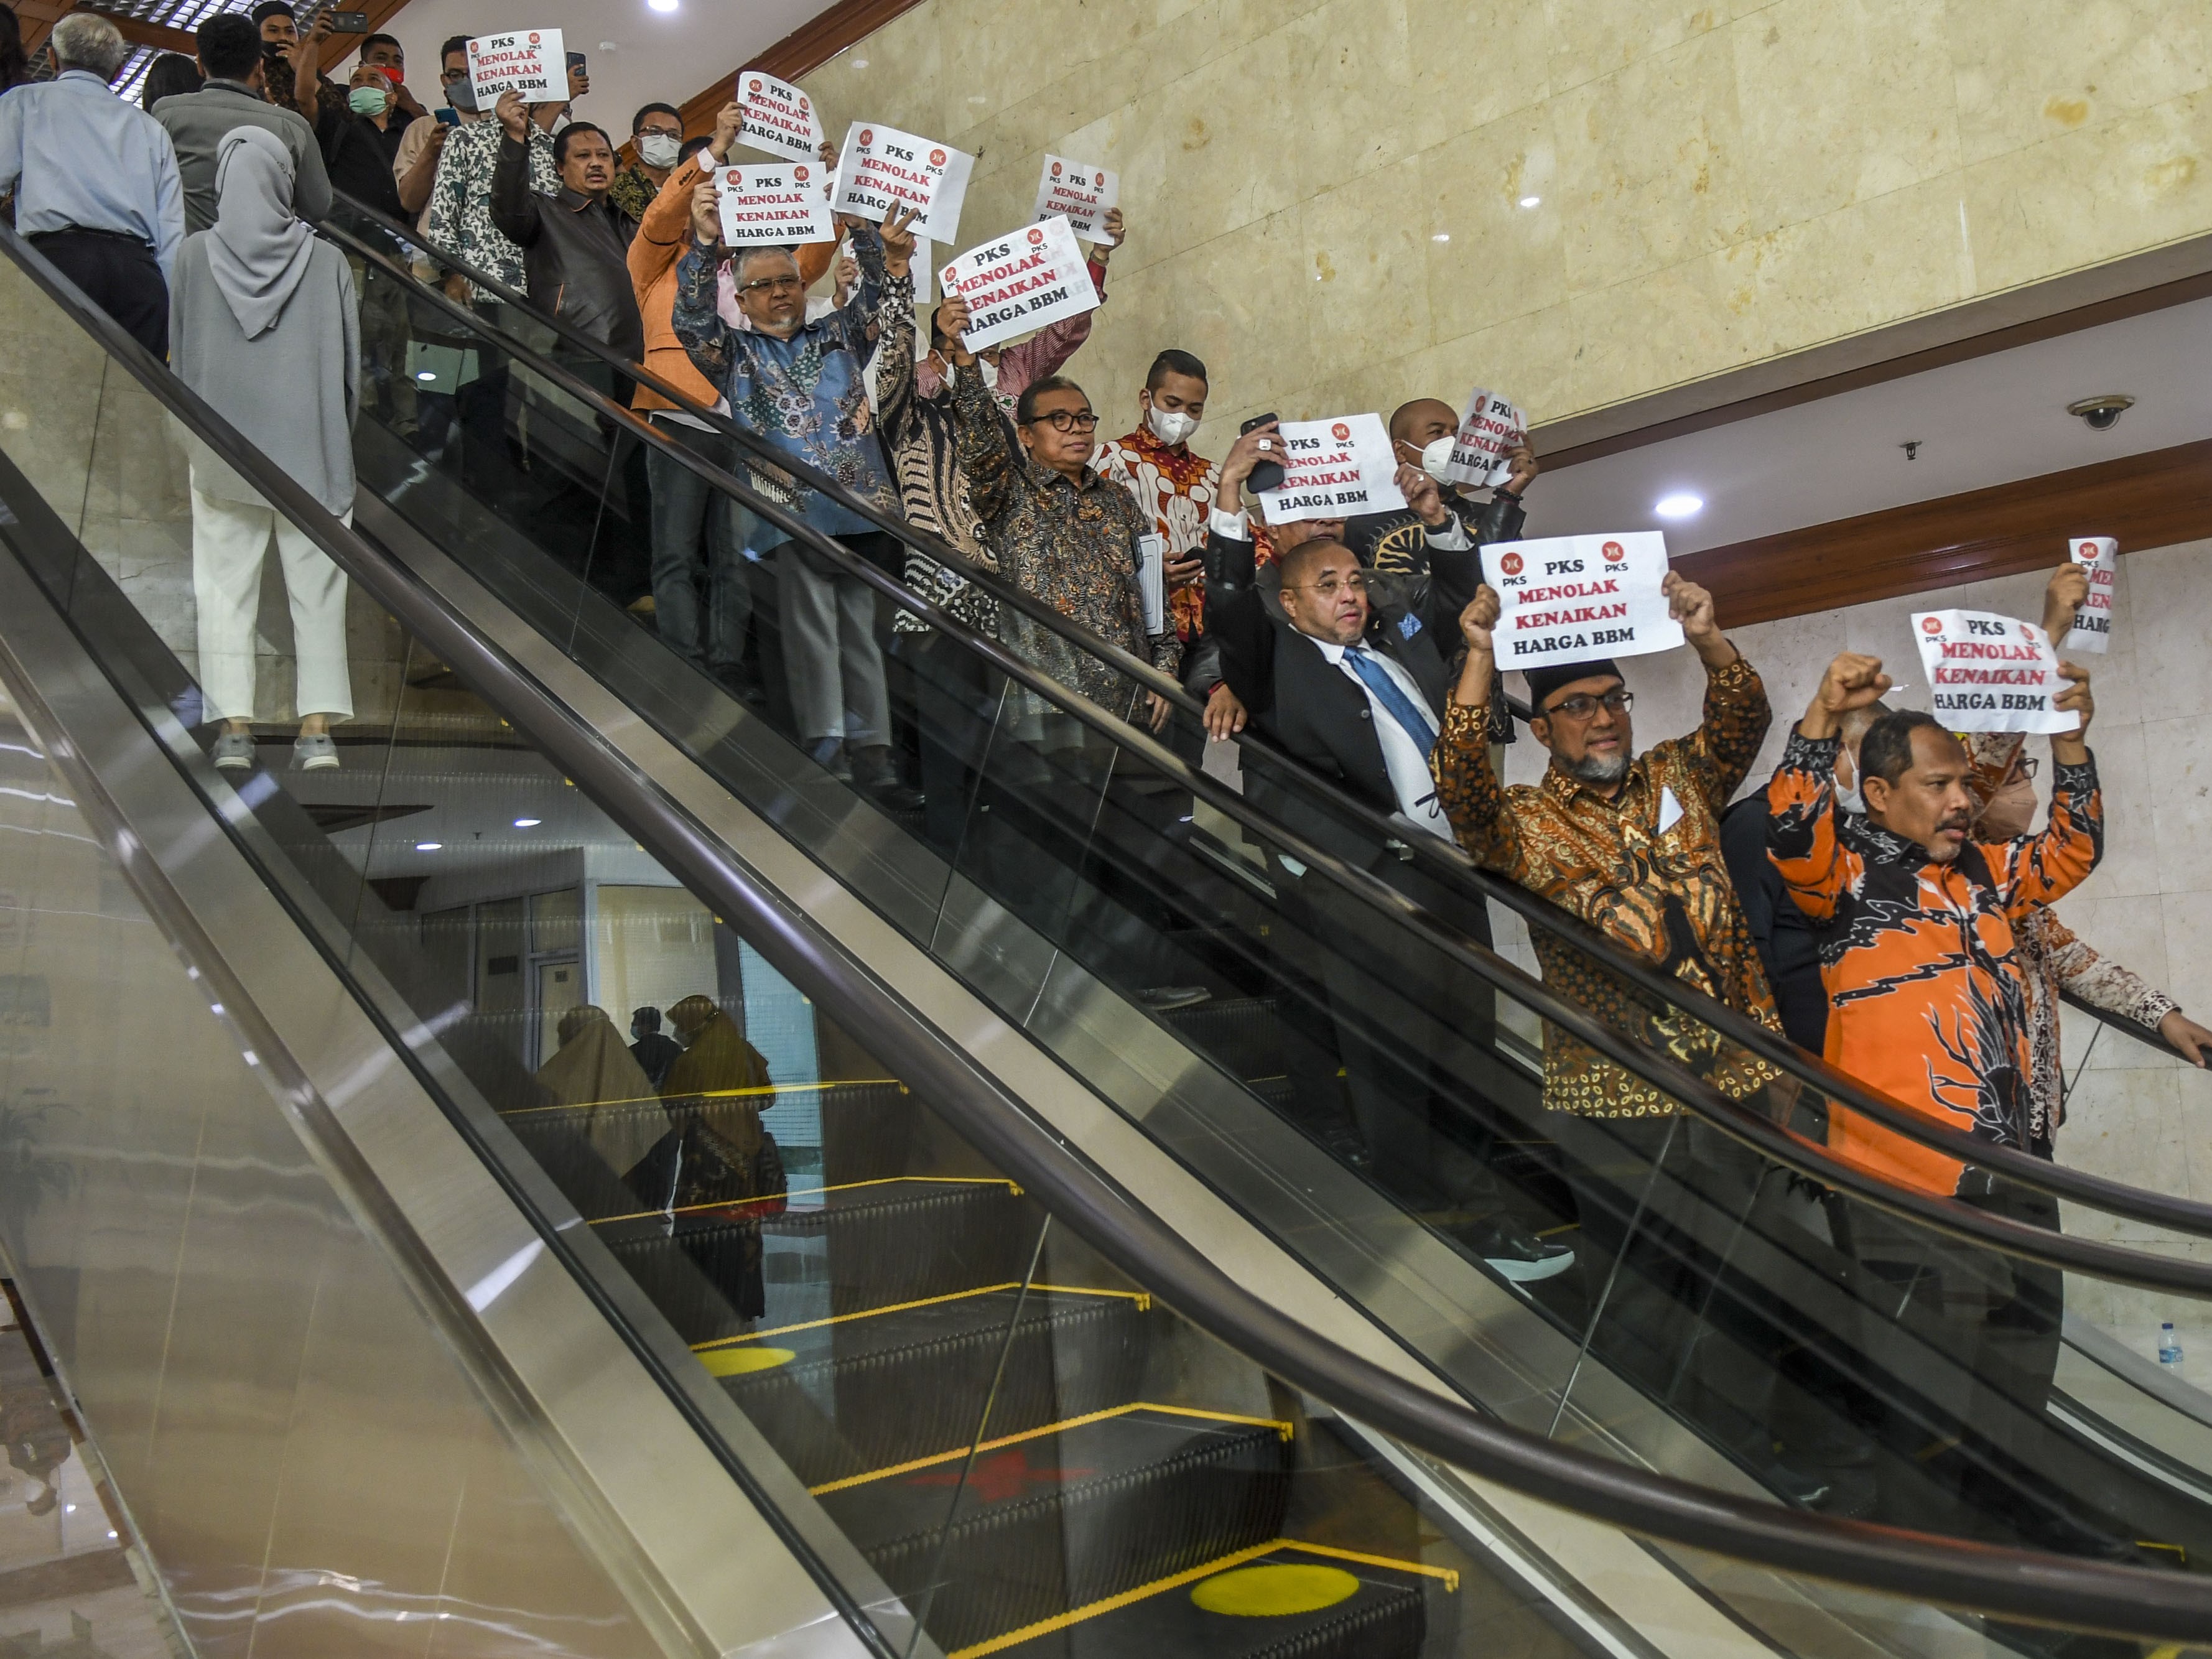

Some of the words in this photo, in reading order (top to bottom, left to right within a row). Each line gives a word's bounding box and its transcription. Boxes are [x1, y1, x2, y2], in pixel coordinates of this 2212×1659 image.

[491, 37, 514, 49] PKS
[477, 50, 537, 67] MENOLAK
[476, 65, 542, 82] KENAIKAN
[477, 81, 514, 97] HARGA
[518, 79, 547, 89] BBM
[770, 85, 792, 101] PKS
[749, 95, 809, 122] MENOLAK
[744, 107, 811, 137] KENAIKAN
[741, 122, 783, 143] HARGA
[786, 136, 812, 152] BBM
[886, 144, 914, 161] PKS
[861, 158, 930, 187] MENOLAK
[926, 165, 943, 175] PKS
[756, 178, 782, 187] PKS
[1069, 175, 1086, 186] PKS
[854, 175, 930, 205] KENAIKAN
[1053, 187, 1097, 204] MENOLAK
[738, 193, 804, 205] MENOLAK
[736, 210, 809, 221] KENAIKAN
[900, 206, 928, 224] BM
[1046, 200, 1095, 217] KENAIKAN
[736, 228, 784, 238] HARGA
[787, 226, 816, 235] BBM
[1071, 220, 1091, 231] BBM
[974, 243, 1010, 266] PKS
[1031, 243, 1048, 253] PKS
[955, 253, 1046, 294] MENOLAK
[947, 278, 959, 290] PKS
[964, 269, 1056, 312] ENAIKAN
[1028, 287, 1069, 311] BBM
[1290, 438, 1320, 450] PKS
[1336, 440, 1354, 448] PKS
[1284, 452, 1352, 470] ENOLAK
[1451, 450, 1489, 471] HARGA
[1278, 494, 1334, 511] HARGA
[1337, 490, 1368, 504] BBM
[1545, 559, 1584, 575] PKS
[1606, 562, 1629, 572] PKS
[1503, 576, 1527, 587] PKS
[1519, 579, 1619, 605] MENOLAK
[1515, 603, 1627, 630] KENAIKAN
[1967, 619, 2005, 635] PKS
[1513, 634, 1587, 654] HARGA
[1592, 628, 1634, 645] BBM
[1941, 643, 2042, 661] MENOLAK
[1935, 667, 2045, 685] KENAIKAN
[1935, 694, 1996, 710] HARGA
[2002, 694, 2047, 711] BBM
